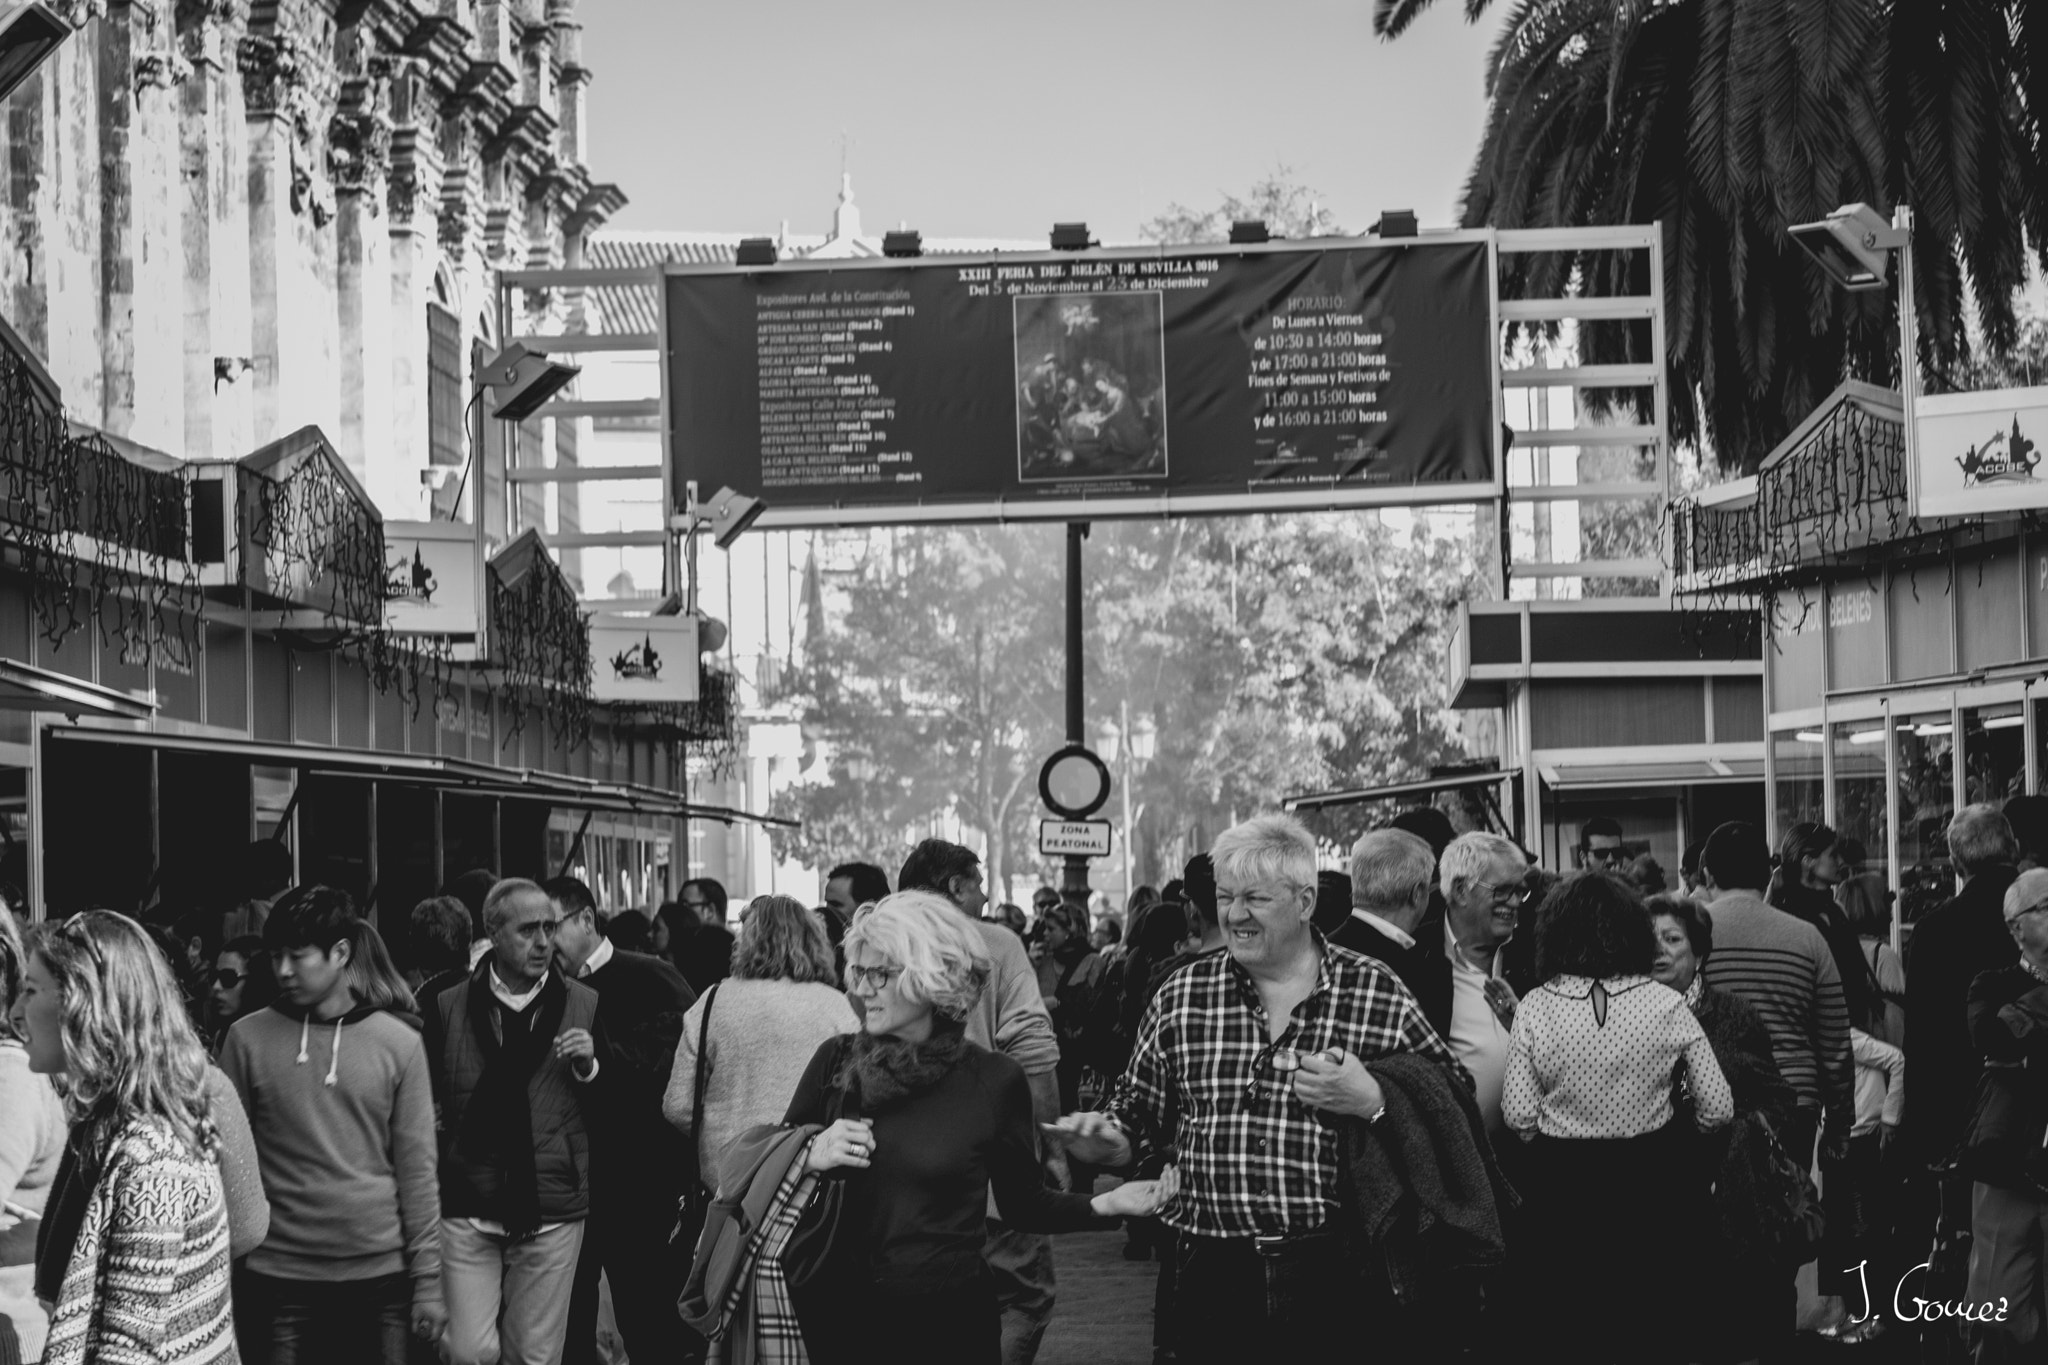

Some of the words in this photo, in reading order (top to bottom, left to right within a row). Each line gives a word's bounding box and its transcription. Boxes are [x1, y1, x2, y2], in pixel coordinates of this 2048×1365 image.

[959, 269, 991, 281] XXIII
[998, 267, 1034, 279] FERIA
[1040, 265, 1065, 278] DEL
[1119, 263, 1135, 274] DE
[1141, 261, 1192, 274] SEVILLA
[1196, 260, 1218, 272] 2016
[969, 283, 989, 296] Del
[994, 281, 1002, 295] 5
[1008, 282, 1021, 295] de
[1025, 280, 1088, 295] Noviembre
[1092, 279, 1103, 291] al
[1107, 276, 1127, 291] 23
[1130, 278, 1145, 290] de
[1148, 276, 1208, 289] Diciembre
[831, 292, 842, 303] de
[844, 292, 852, 302] la
[1288, 296, 1347, 311] HORARIO:
[1273, 316, 1286, 329] De
[1288, 315, 1316, 328] Lunes
[1319, 317, 1324, 326] a
[1326, 313, 1363, 326] Viernes
[1255, 337, 1266, 350] de
[1270, 334, 1303, 350] 10:30
[1307, 336, 1313, 347] a
[1318, 331, 1351, 347] 14:00
[1354, 332, 1382, 346] horas
[1252, 360, 1257, 373] y
[1260, 357, 1271, 370] de
[1275, 354, 1308, 370] 17:00
[1311, 356, 1318, 367] a
[1322, 352, 1356, 367] 21:00
[1358, 353, 1386, 366] horas
[1249, 375, 1274, 388] Fines
[1276, 374, 1288, 386] de
[1290, 373, 1327, 385] Semana
[1330, 374, 1335, 386] y
[1338, 370, 1377, 383] Festivos
[1379, 369, 1391, 381] de
[812, 400, 834, 410] Calle
[837, 399, 856, 410] Fray
[1264, 392, 1298, 407] 11:00
[1302, 394, 1308, 405] a
[1313, 389, 1346, 405] 15:00
[1349, 390, 1377, 404] horas
[1254, 416, 1260, 430] y
[1263, 414, 1275, 427] de
[1279, 411, 1310, 426] 16:00
[1314, 413, 1320, 425] a
[1324, 409, 1356, 424] 21:00
[1359, 409, 1387, 423] horas
[1830, 590, 1871, 627] BELENES
[1061, 825, 1090, 834] ZONA
[1047, 838, 1103, 849] PEATONAL
